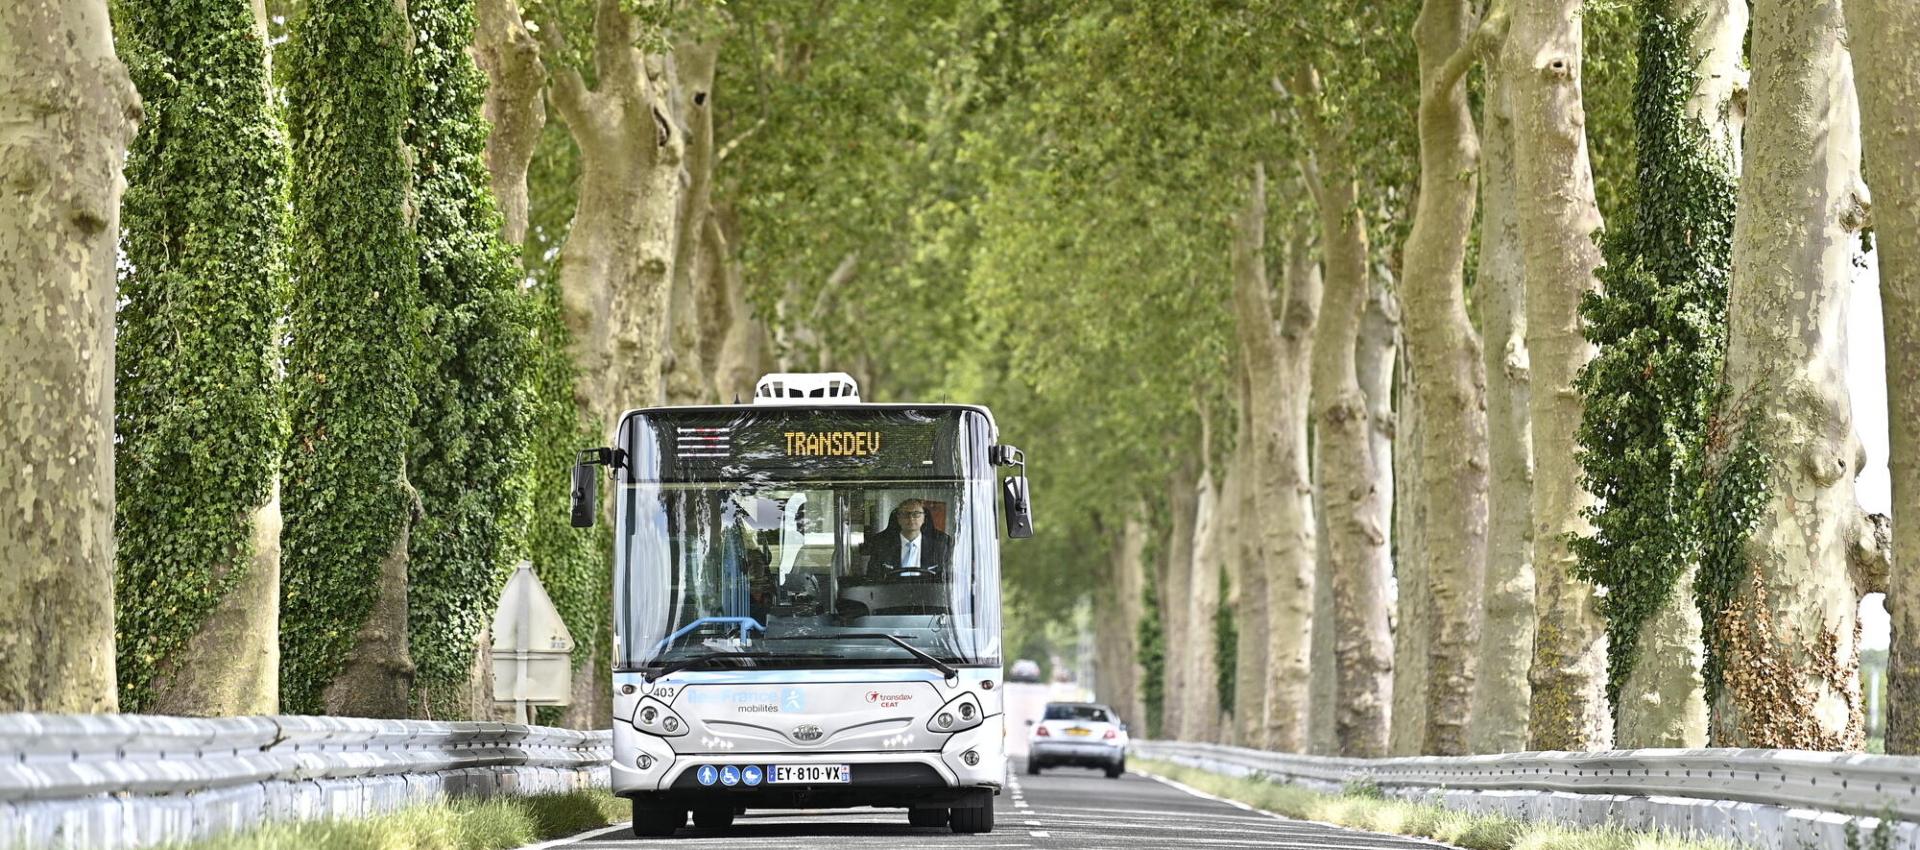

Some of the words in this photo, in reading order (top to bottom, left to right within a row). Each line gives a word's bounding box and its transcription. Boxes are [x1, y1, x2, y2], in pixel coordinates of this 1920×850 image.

[784, 431, 880, 456] TRANSDEV
[653, 687, 675, 698] 403
[880, 693, 913, 701] transdev
[738, 703, 779, 713] mobilités
[777, 767, 840, 781] EY-810-VX
